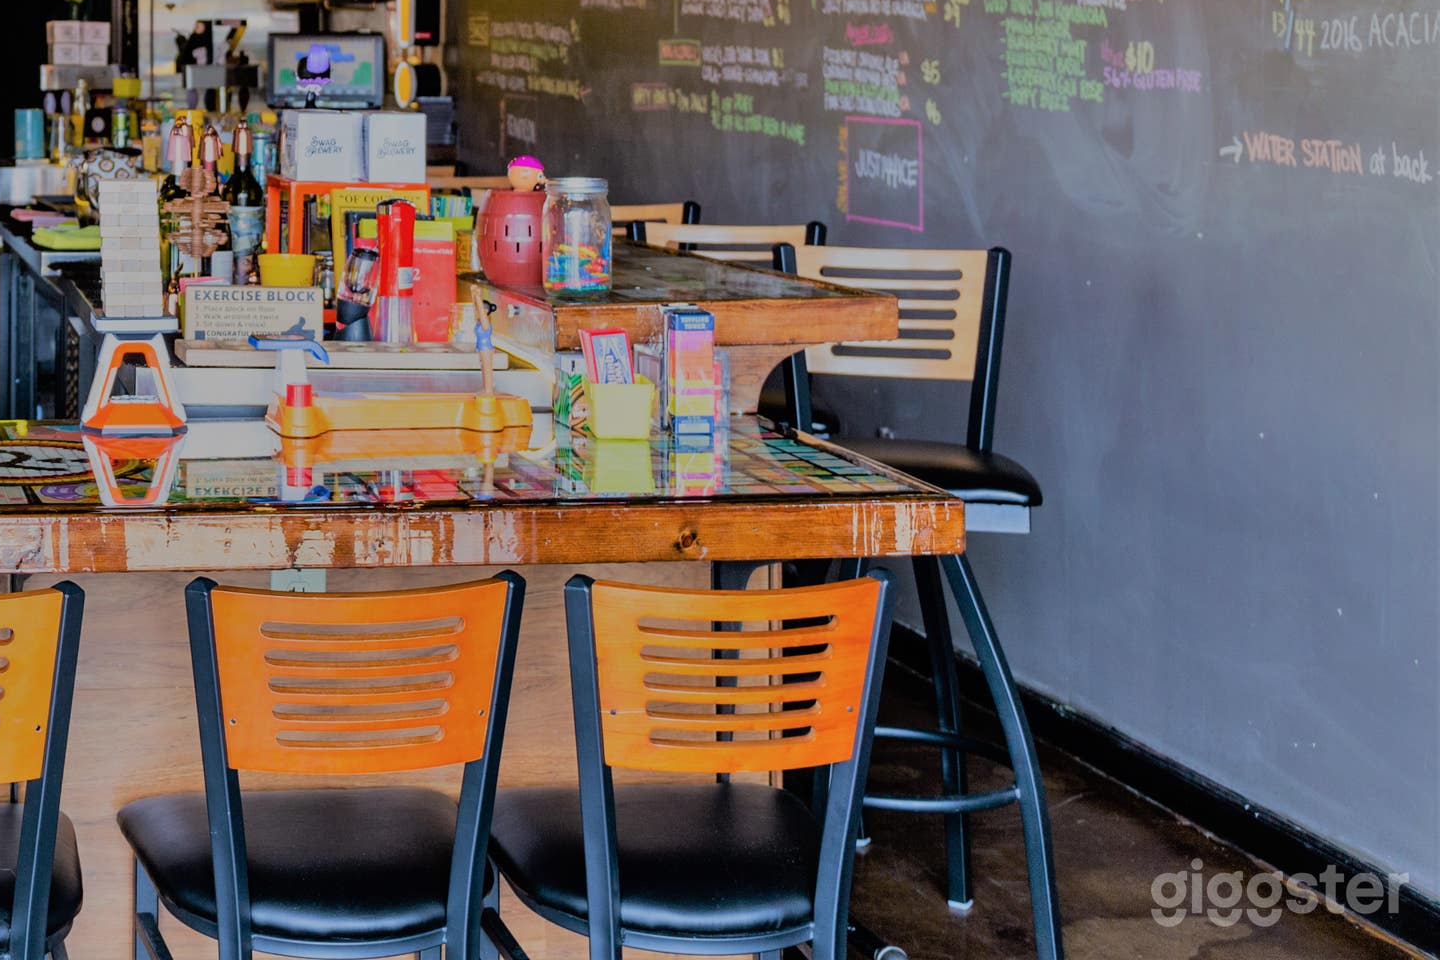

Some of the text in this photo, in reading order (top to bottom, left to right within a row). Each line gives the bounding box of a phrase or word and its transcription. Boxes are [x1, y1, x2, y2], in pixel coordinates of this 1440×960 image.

[1319, 15, 1363, 53] 2016
[1243, 131, 1433, 184] WATER STATION at back
[194, 290, 316, 302] EXERCISE BLOCK
[203, 305, 223, 313] Place
[224, 305, 246, 313] block
[203, 313, 222, 321] Walk
